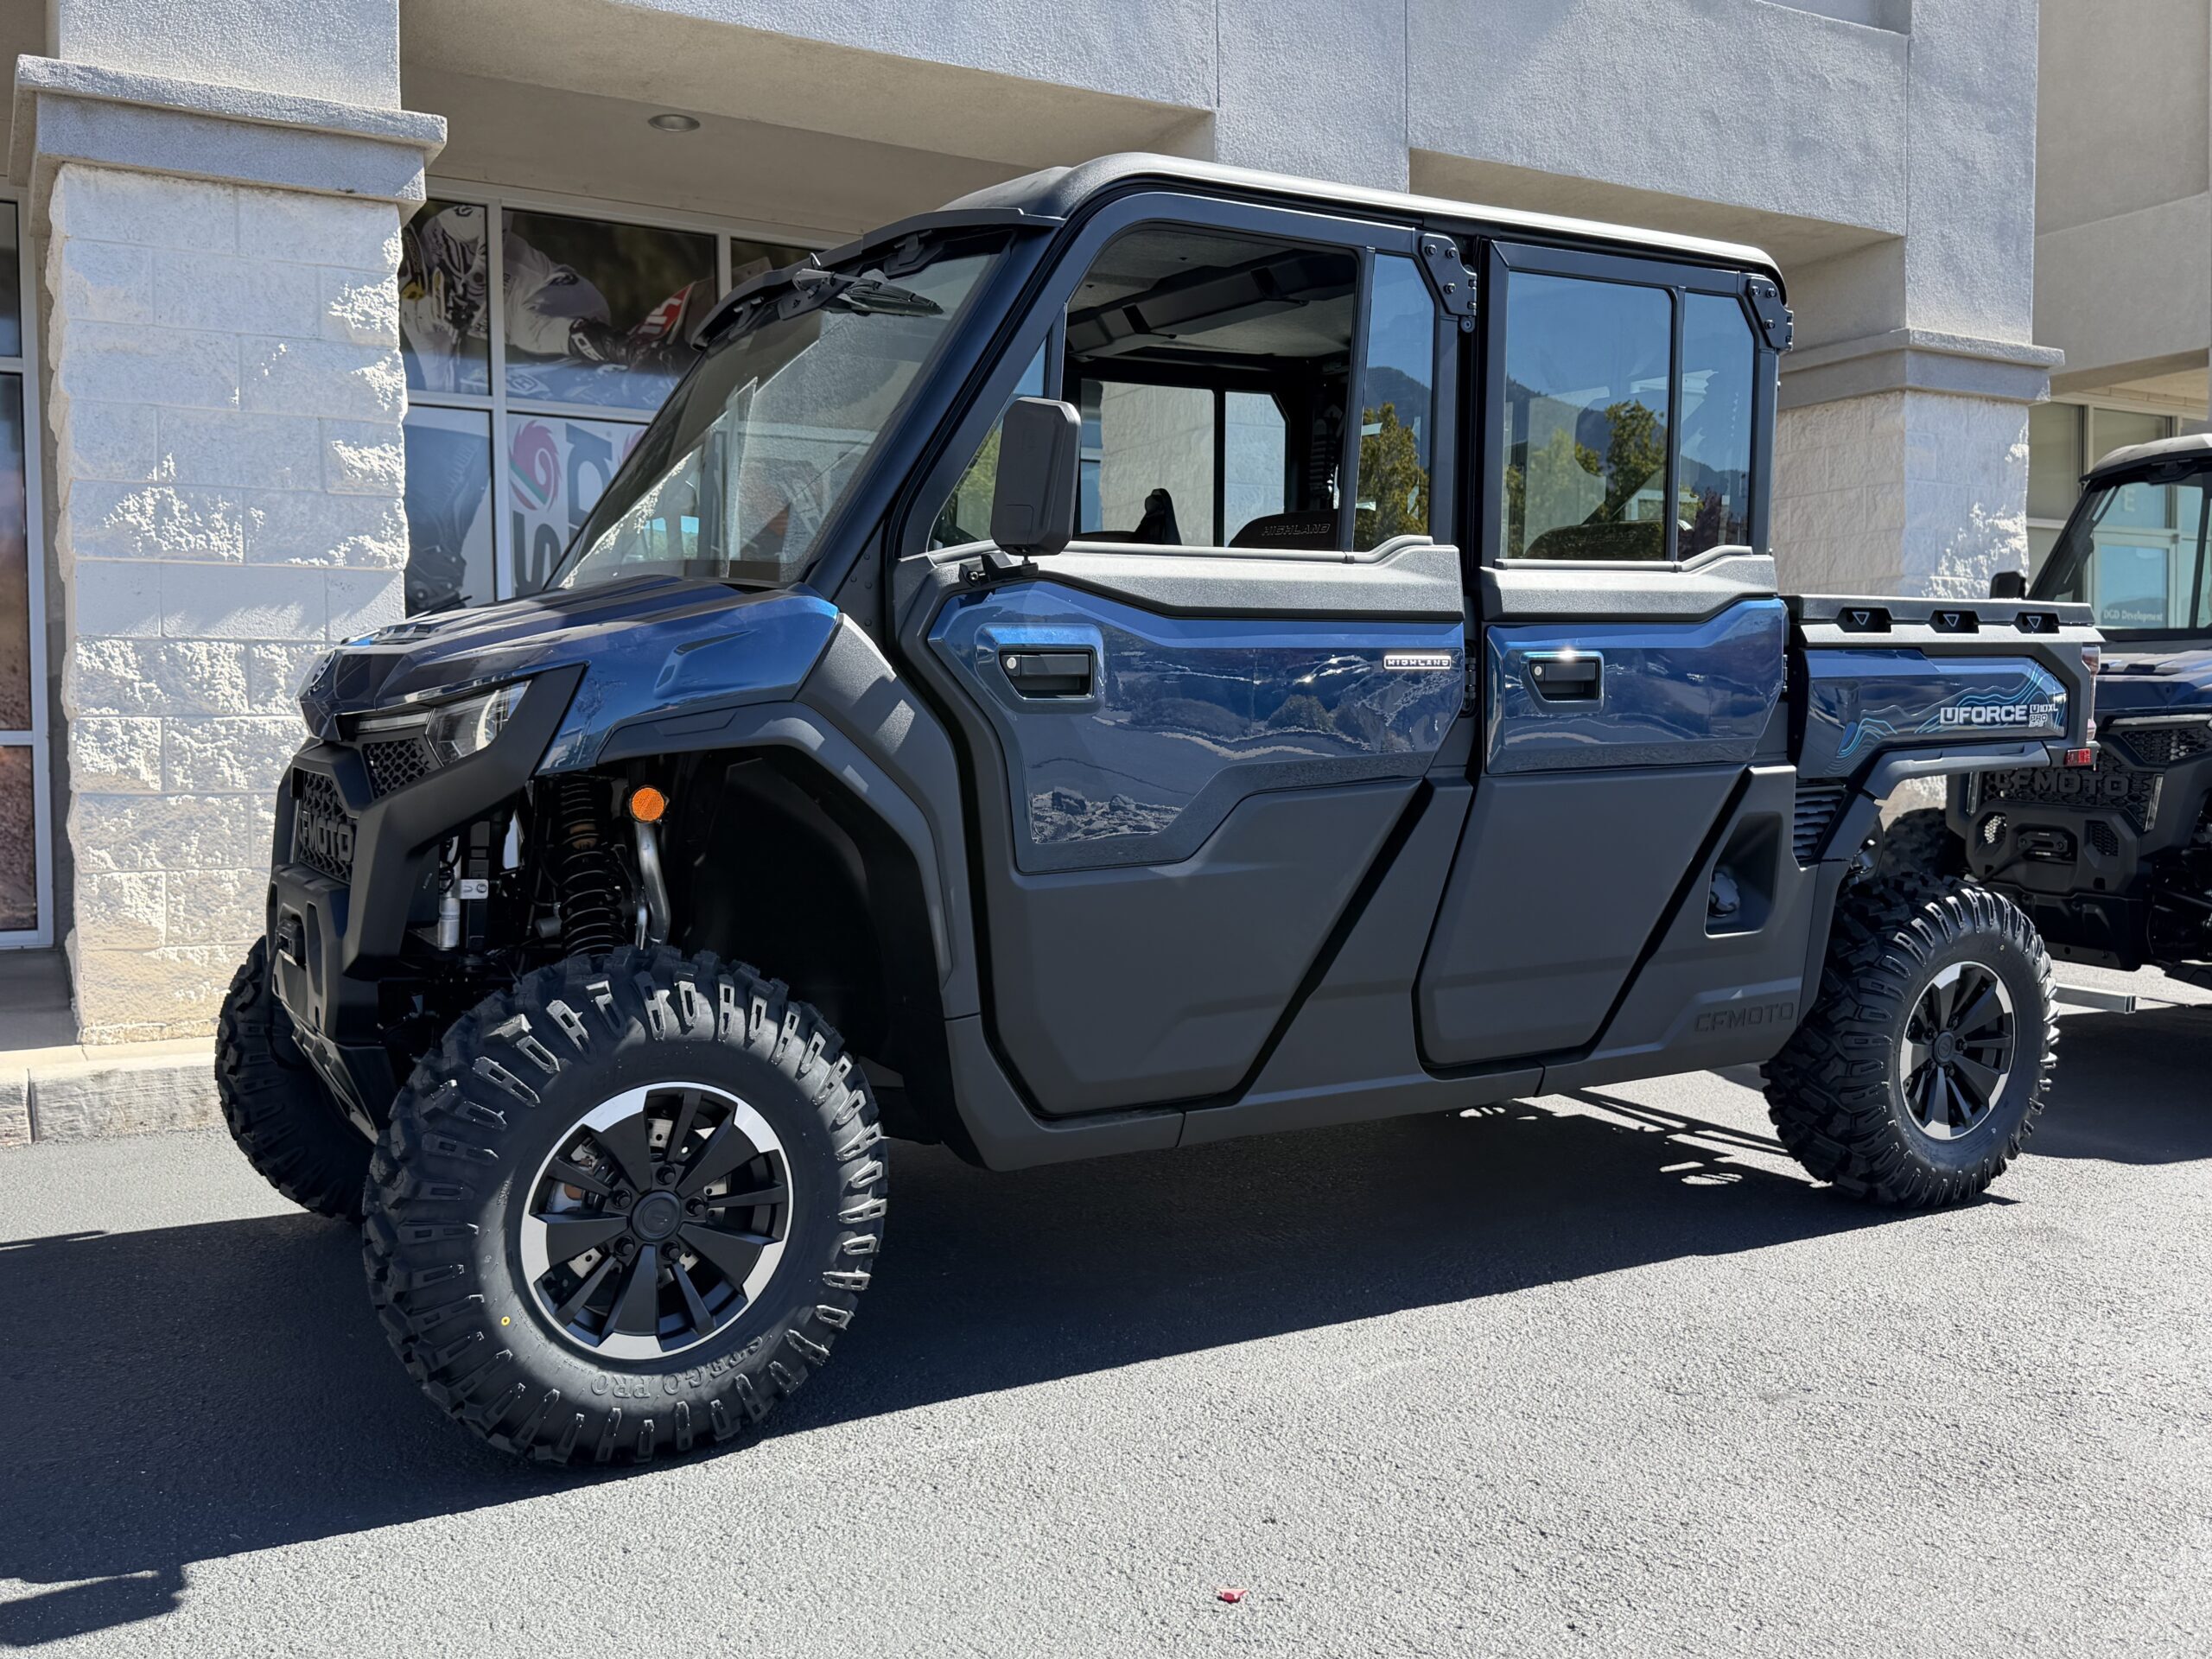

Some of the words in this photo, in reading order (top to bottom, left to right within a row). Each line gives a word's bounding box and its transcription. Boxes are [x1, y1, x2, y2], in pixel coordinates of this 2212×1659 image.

[1262, 524, 1331, 536] HIGHLAND
[1940, 705, 2027, 724] UFORCE
[1694, 1002, 1794, 1032] CFMOTO
[591, 1371, 653, 1399] PRO
